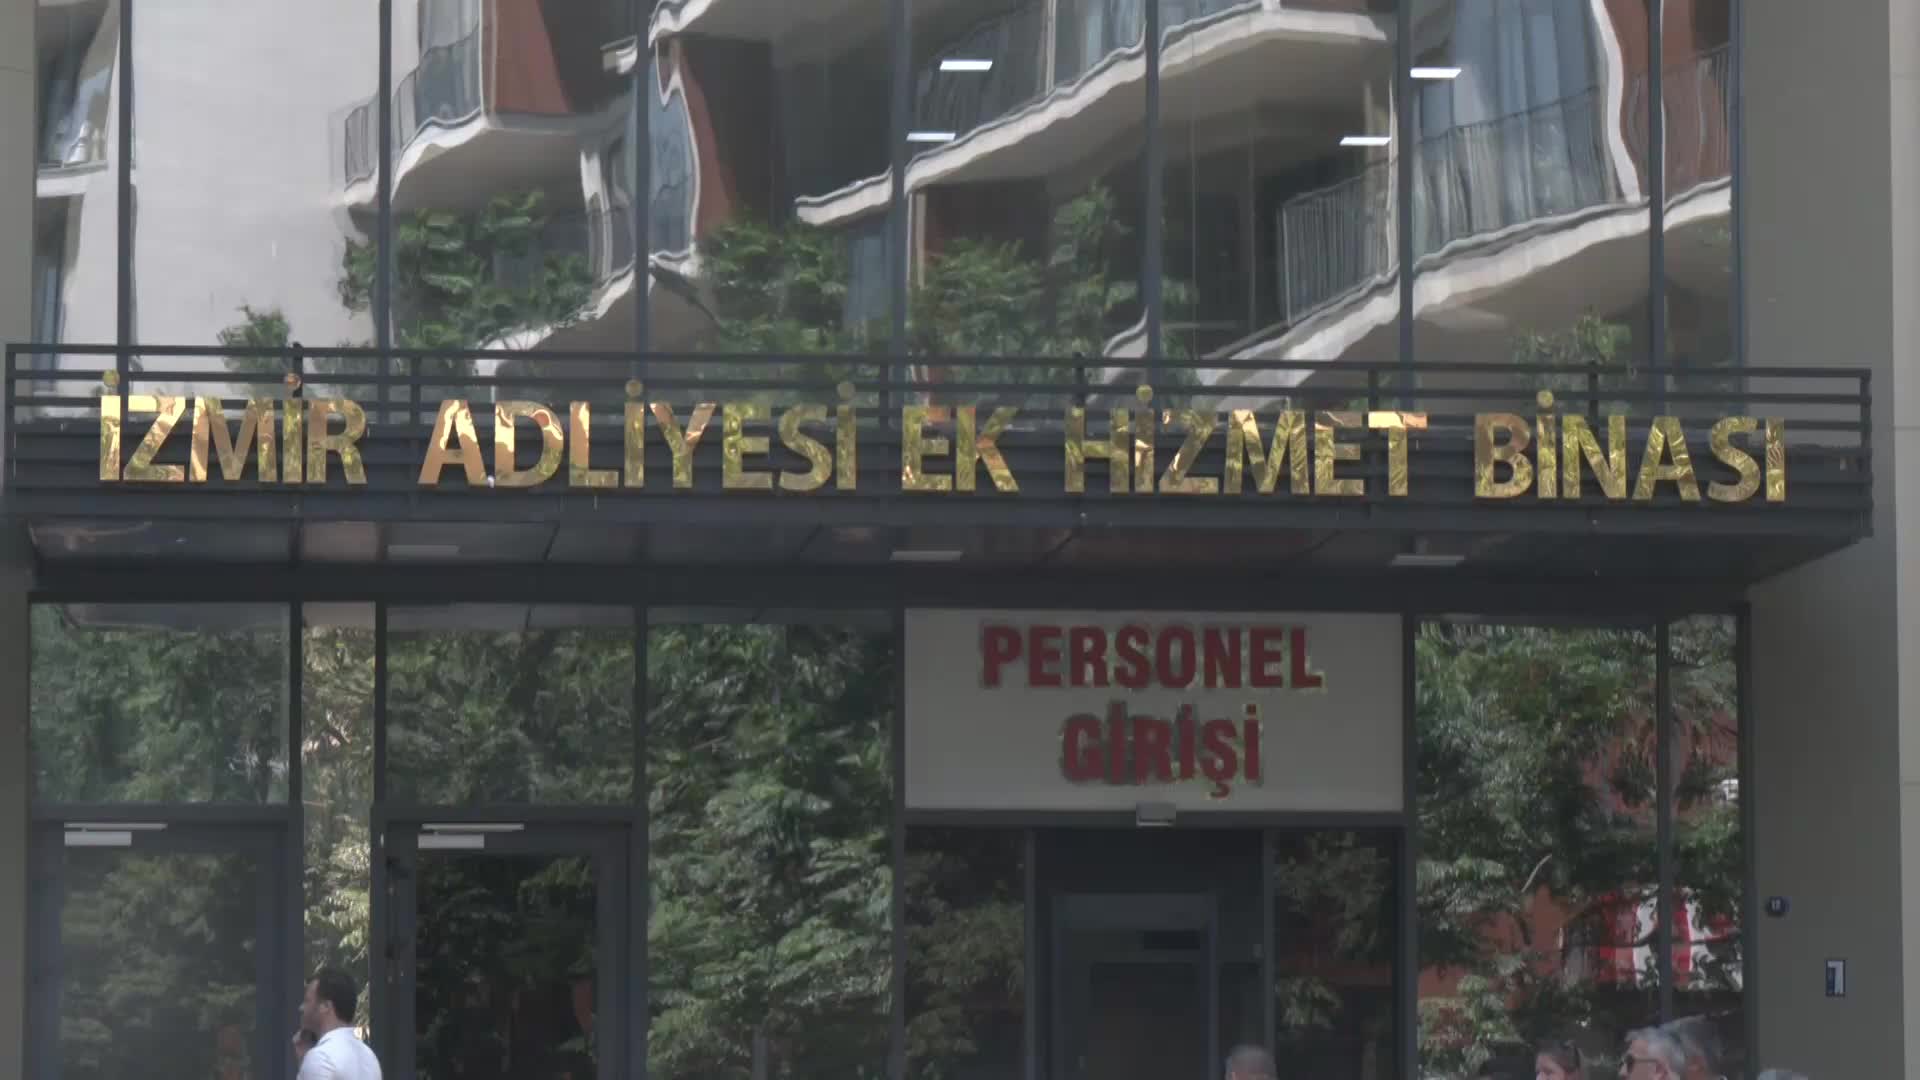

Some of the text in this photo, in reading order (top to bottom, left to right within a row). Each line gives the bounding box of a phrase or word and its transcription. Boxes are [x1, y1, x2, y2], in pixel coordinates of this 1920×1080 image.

[99, 369, 1786, 501] İZMİR ADLİYESİ EK HİZMET BİNASI
[980, 625, 1326, 690] PERSONEL
[1060, 703, 1263, 799] GİRİŞİ
